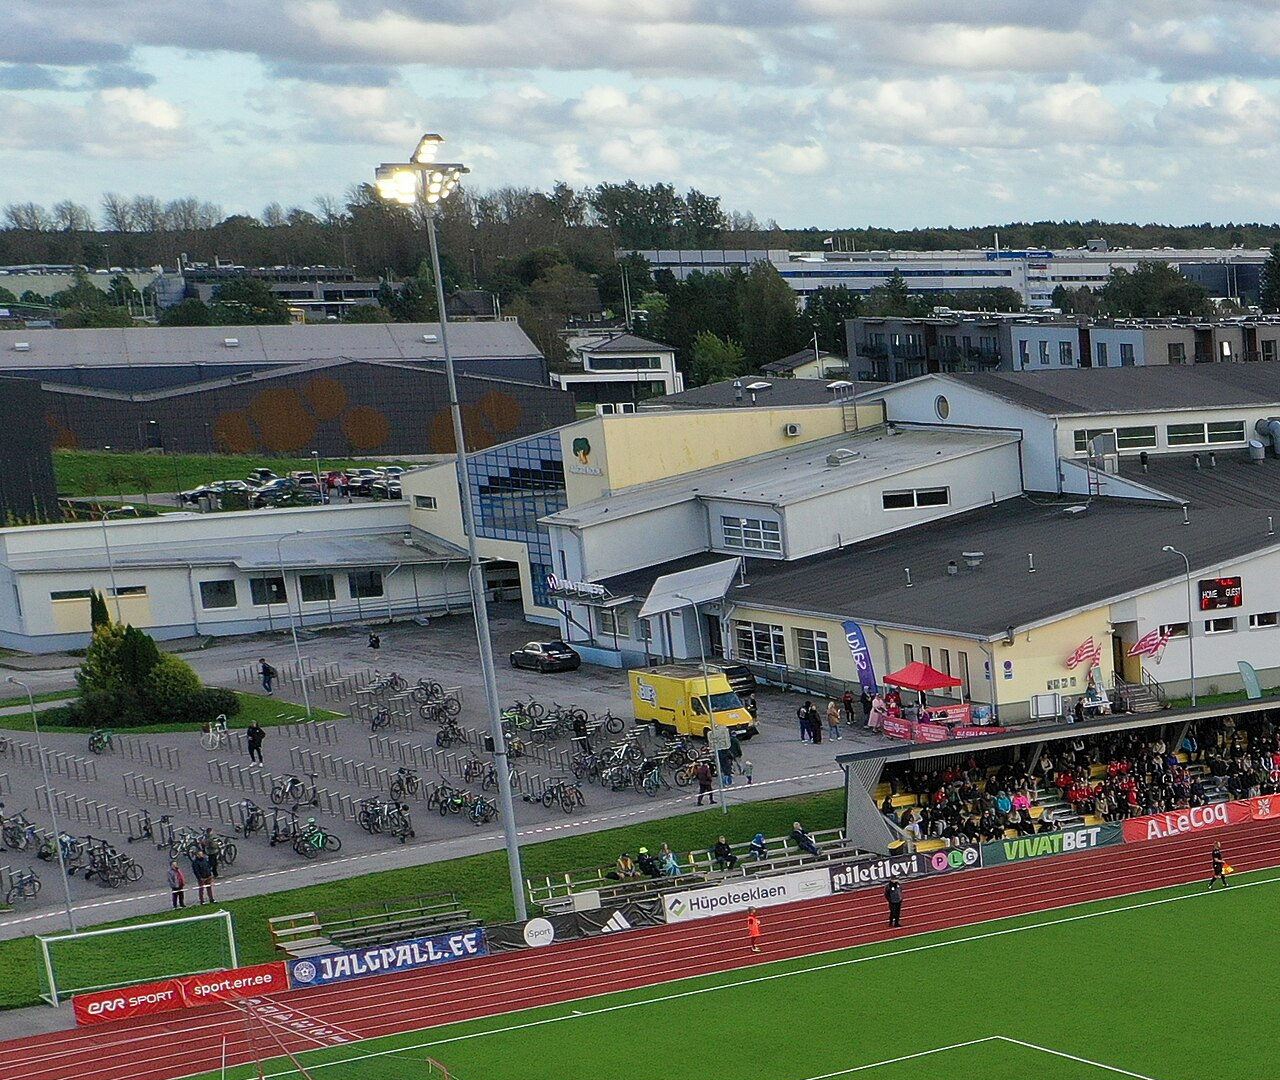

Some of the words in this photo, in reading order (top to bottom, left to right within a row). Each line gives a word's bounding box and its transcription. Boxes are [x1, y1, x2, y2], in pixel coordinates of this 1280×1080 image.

[1202, 590, 1218, 598] HOME
[1225, 587, 1241, 596] GUEST
[1003, 827, 1101, 860] VIVATBET
[833, 855, 918, 891] piletilevi
[689, 885, 786, 912] Hüpoteeklaen
[321, 932, 477, 979] JALGPALL.EE
[129, 990, 174, 1007] SPORT
[194, 973, 273, 997] sport.err.ee
